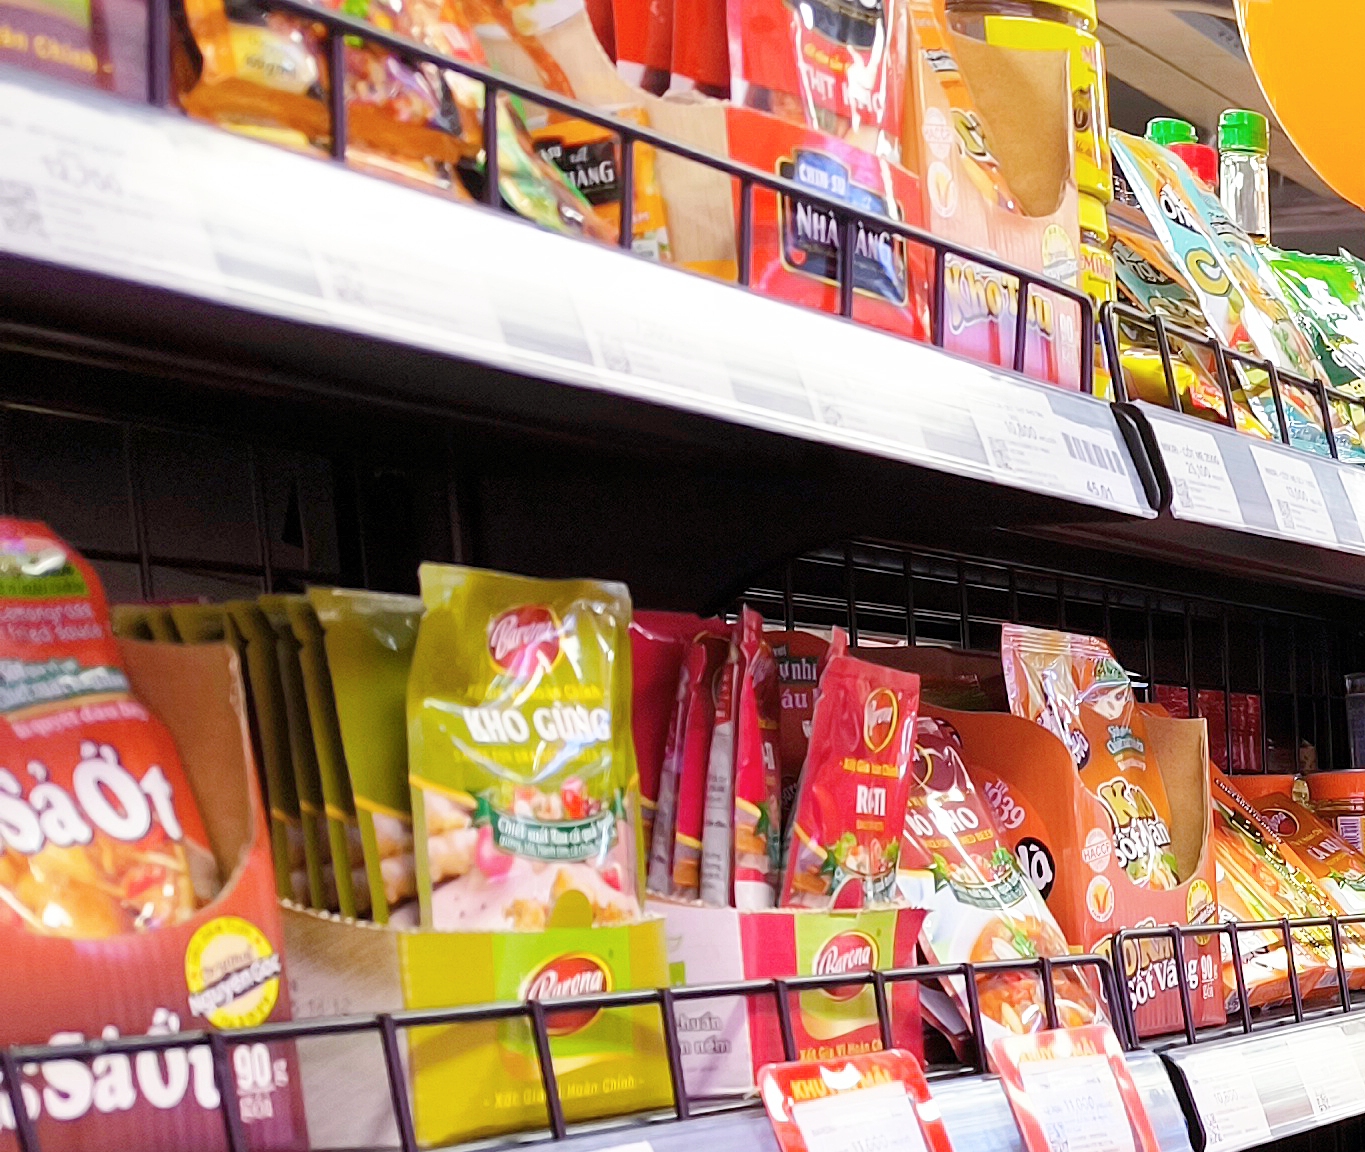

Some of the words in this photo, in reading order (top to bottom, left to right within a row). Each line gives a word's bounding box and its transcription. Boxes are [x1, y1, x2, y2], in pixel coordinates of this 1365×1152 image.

[796, 200, 839, 249] NHÀ
[850, 219, 892, 260] ÀNG
[462, 705, 531, 744] KHO
[232, 1042, 272, 1090] 90
